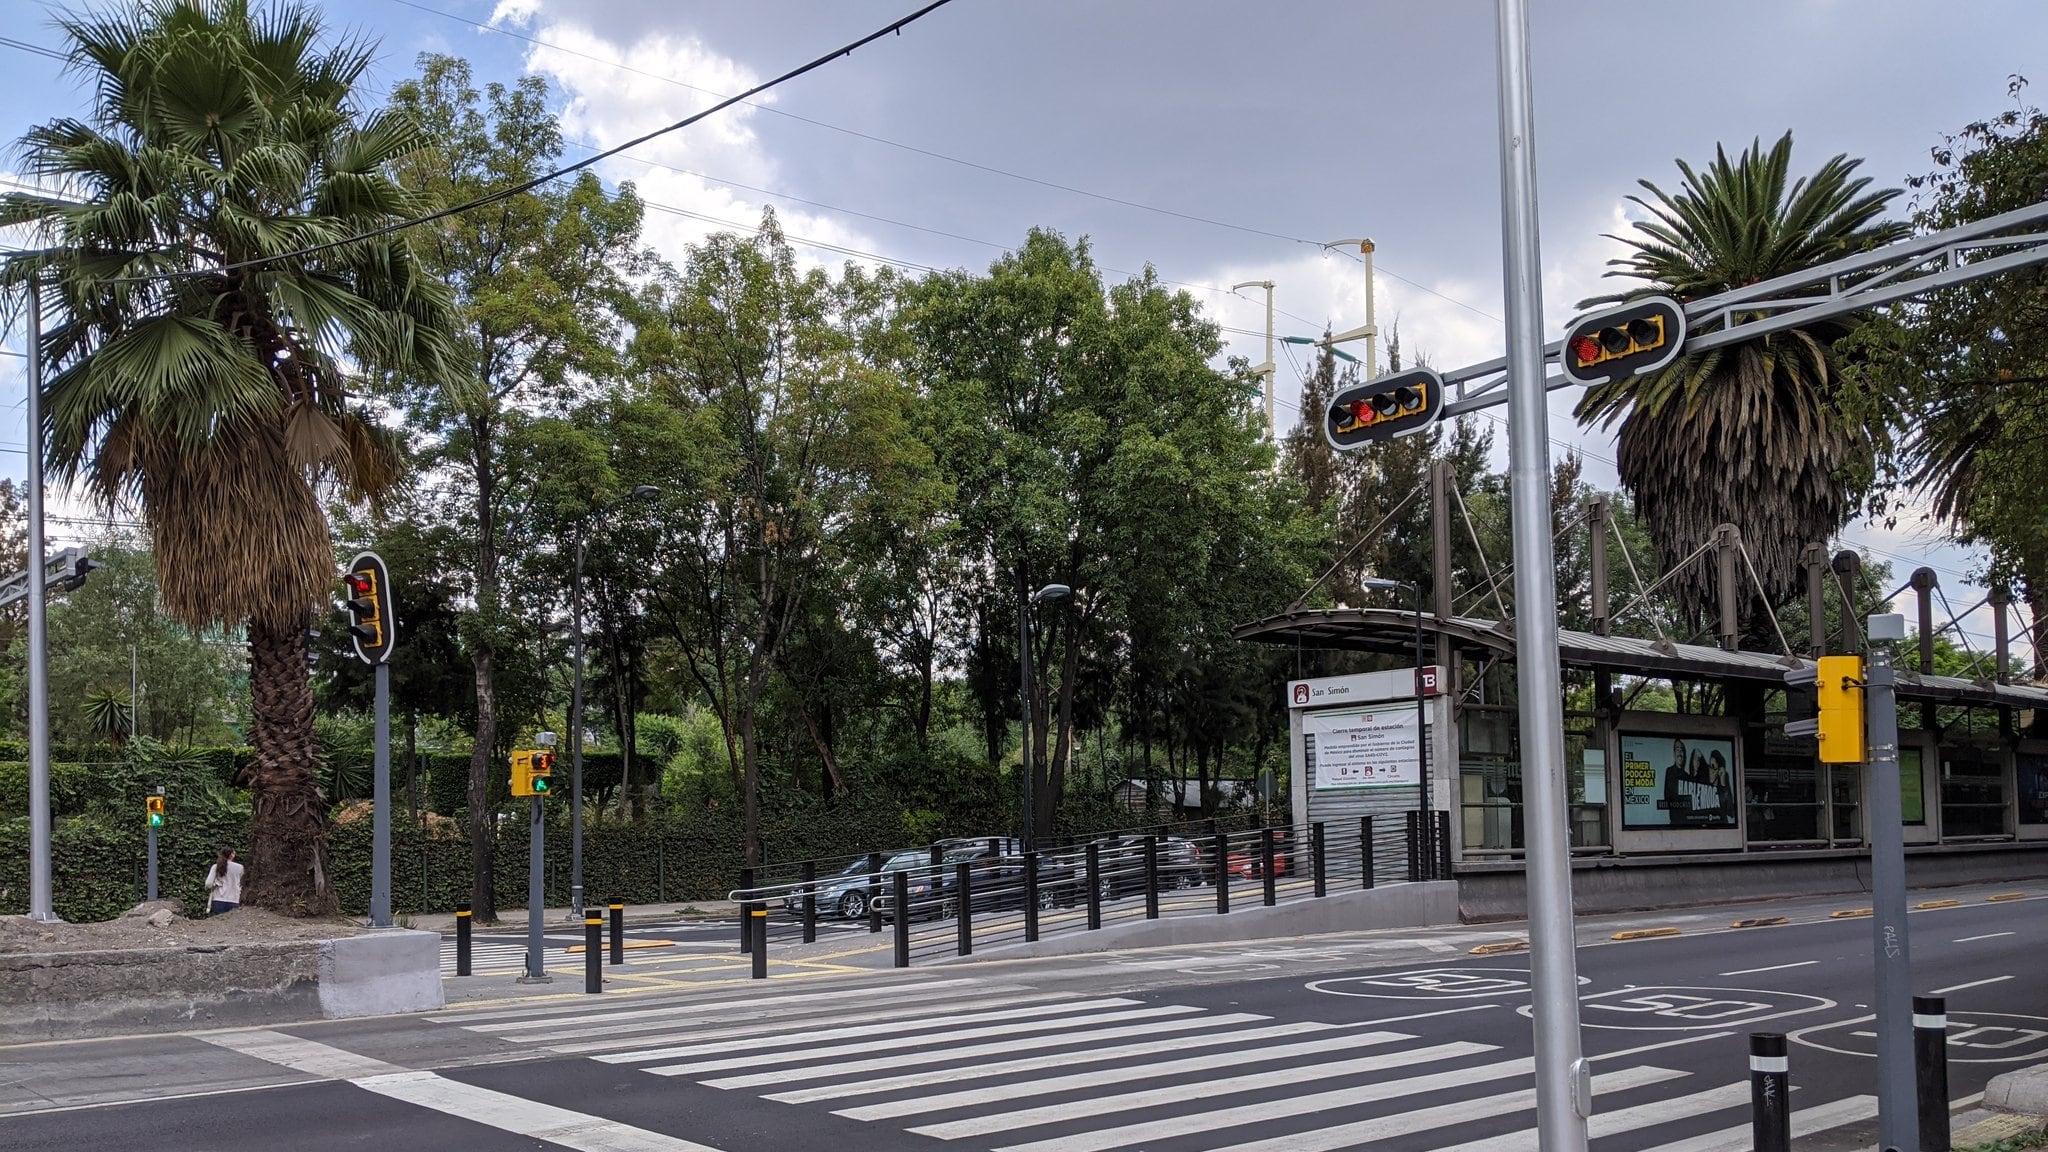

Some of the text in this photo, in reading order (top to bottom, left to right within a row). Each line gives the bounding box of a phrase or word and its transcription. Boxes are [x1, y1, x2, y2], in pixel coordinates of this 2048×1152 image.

[1312, 686, 1349, 696] San Simón
[1625, 770, 1654, 778] PODCAST
[1361, 973, 1528, 992] 50
[1585, 994, 1774, 1019] 50
